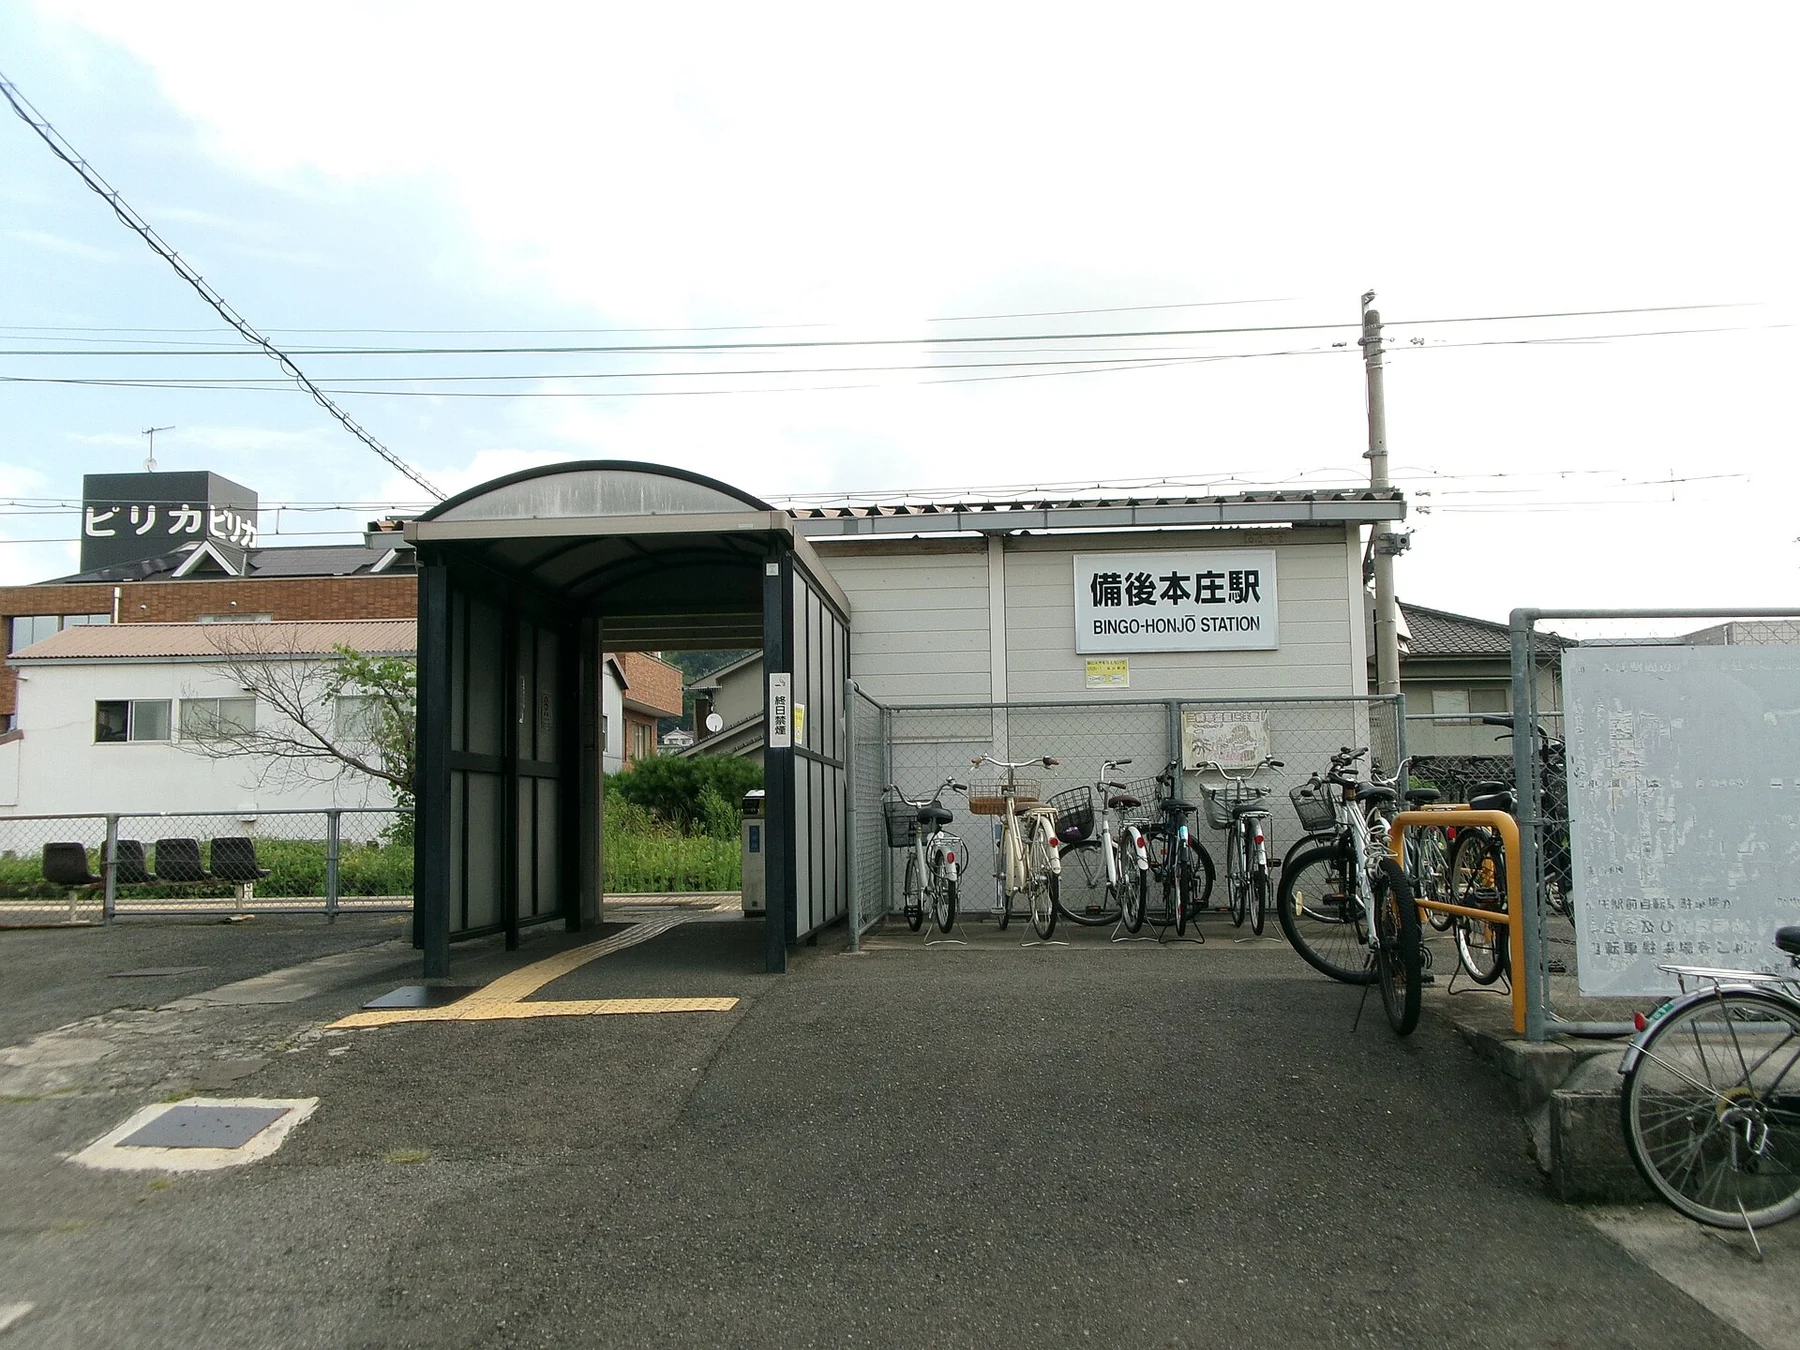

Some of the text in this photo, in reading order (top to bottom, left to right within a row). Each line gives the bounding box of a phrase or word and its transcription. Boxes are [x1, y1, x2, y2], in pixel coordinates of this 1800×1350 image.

[209, 504, 257, 549] ピリカ
[1090, 569, 1261, 608] 備後本庄駅
[1093, 614, 1260, 635] BINGO-HONJŌ STATION
[774, 695, 786, 736] 終日禁煙
